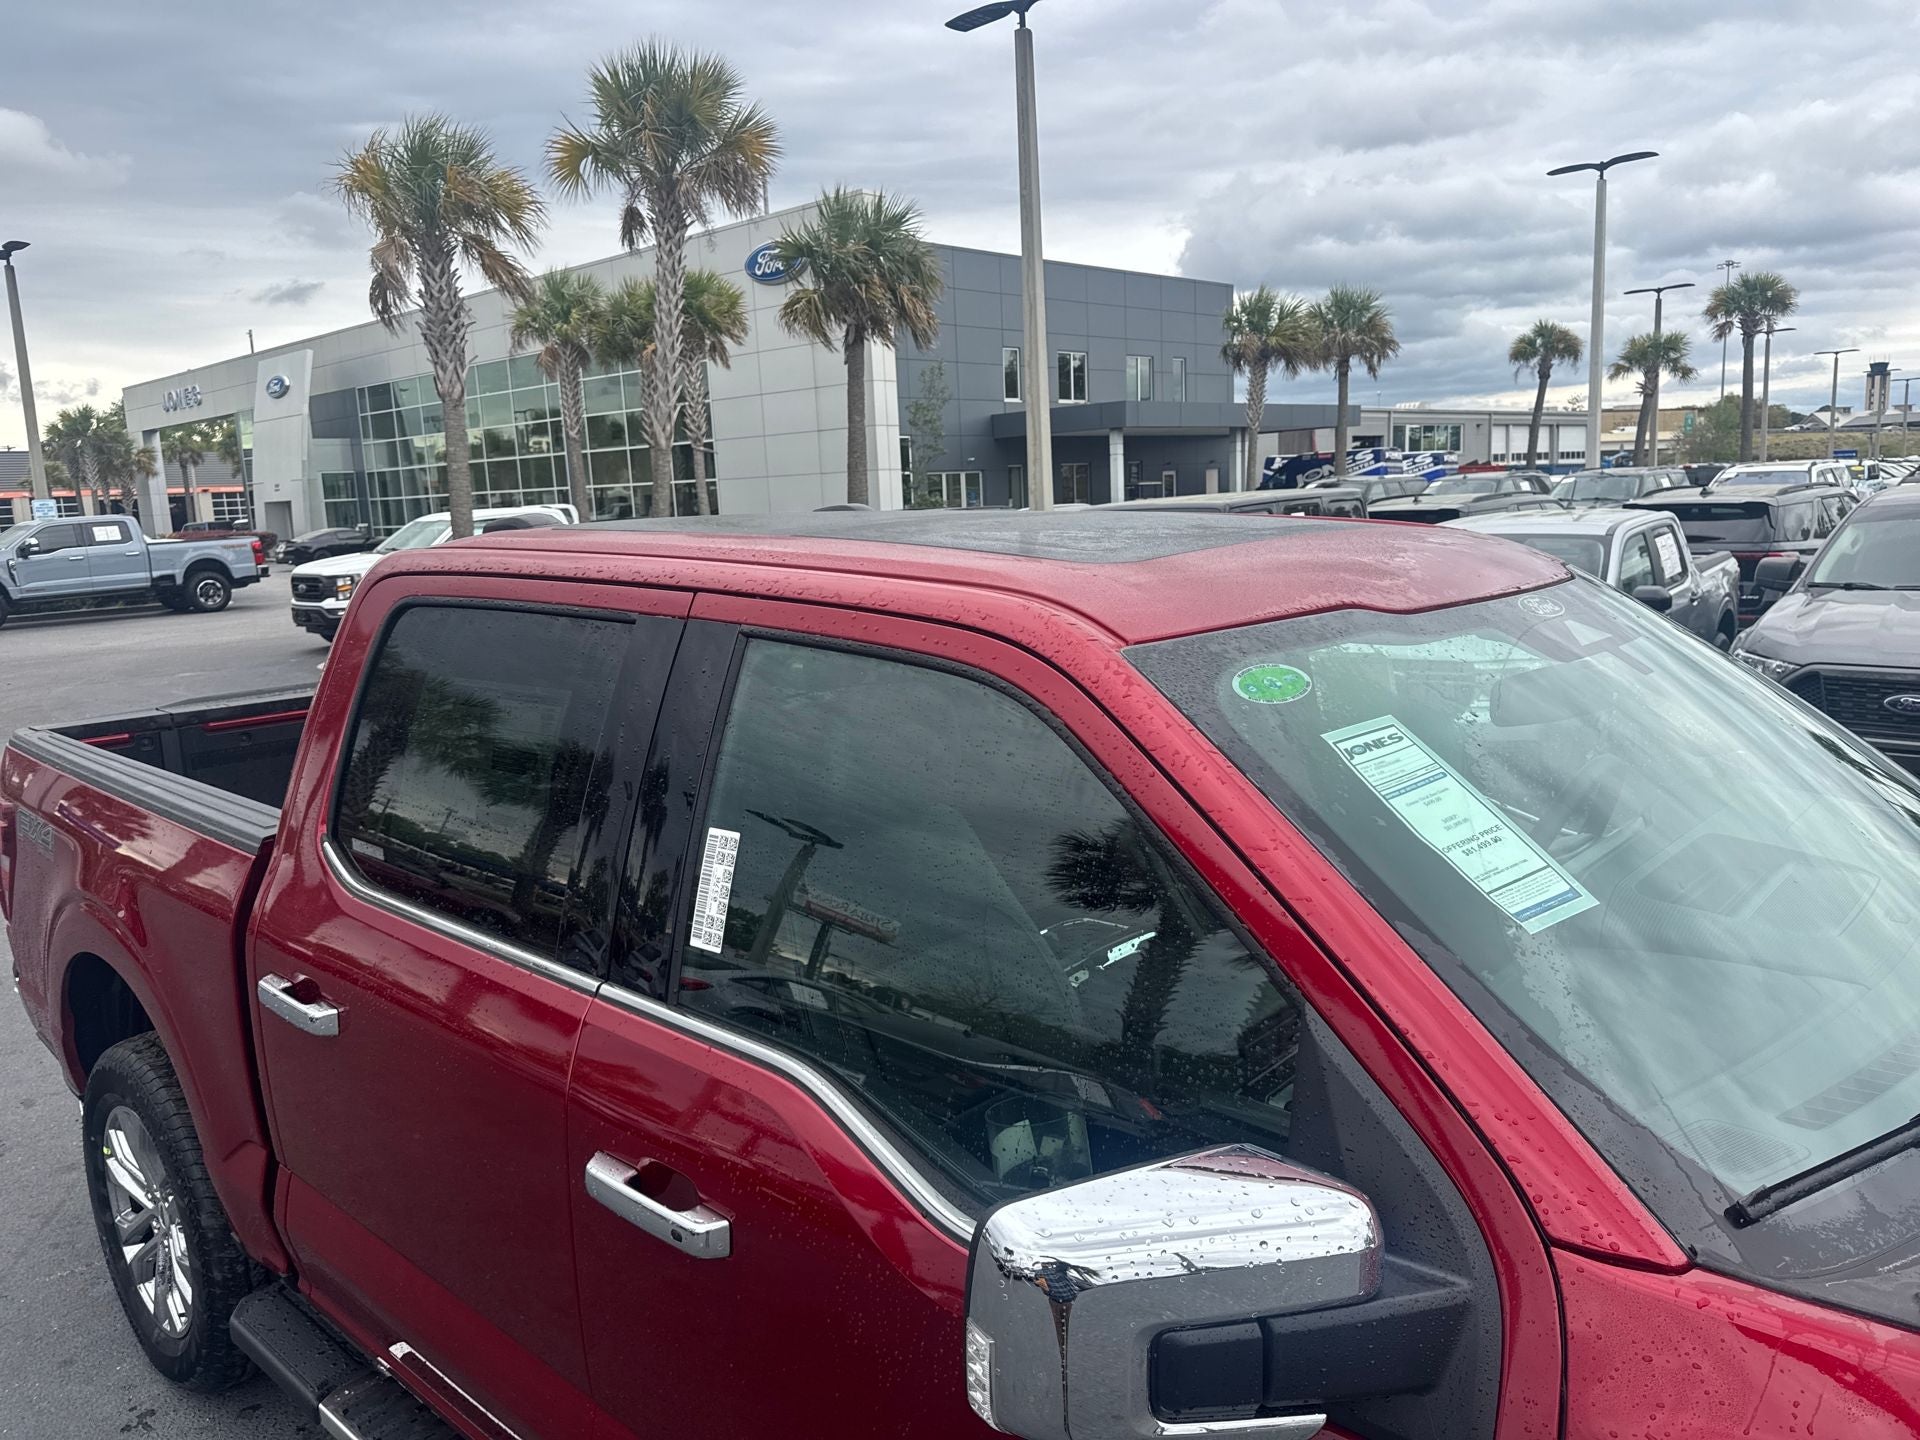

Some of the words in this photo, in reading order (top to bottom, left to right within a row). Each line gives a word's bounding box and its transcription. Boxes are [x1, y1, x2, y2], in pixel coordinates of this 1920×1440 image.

[754, 248, 785, 276] For
[162, 385, 202, 412] JONES
[1343, 732, 1405, 761] JONES
[1441, 834, 1480, 854] OFFERING
[1478, 823, 1505, 838] PRICE:
